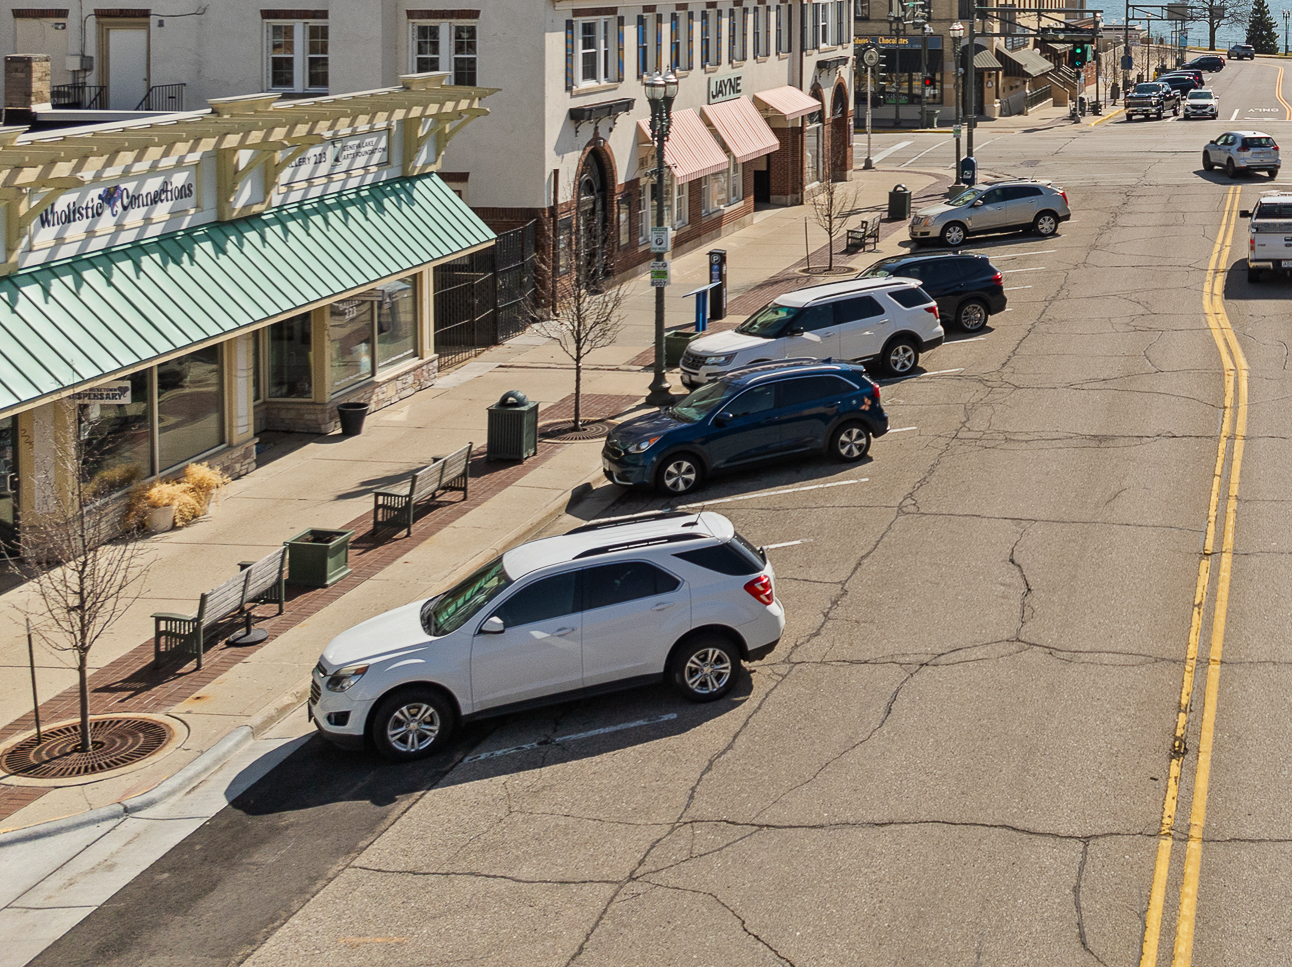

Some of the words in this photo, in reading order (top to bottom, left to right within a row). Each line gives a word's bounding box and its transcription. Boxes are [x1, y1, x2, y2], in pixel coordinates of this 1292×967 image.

[711, 75, 742, 99] JAYNE
[362, 139, 374, 147] LAKE
[314, 151, 327, 165] 223
[39, 193, 104, 229] Wholistic
[120, 180, 194, 212] Connections
[68, 392, 122, 401] ISPENSARY
